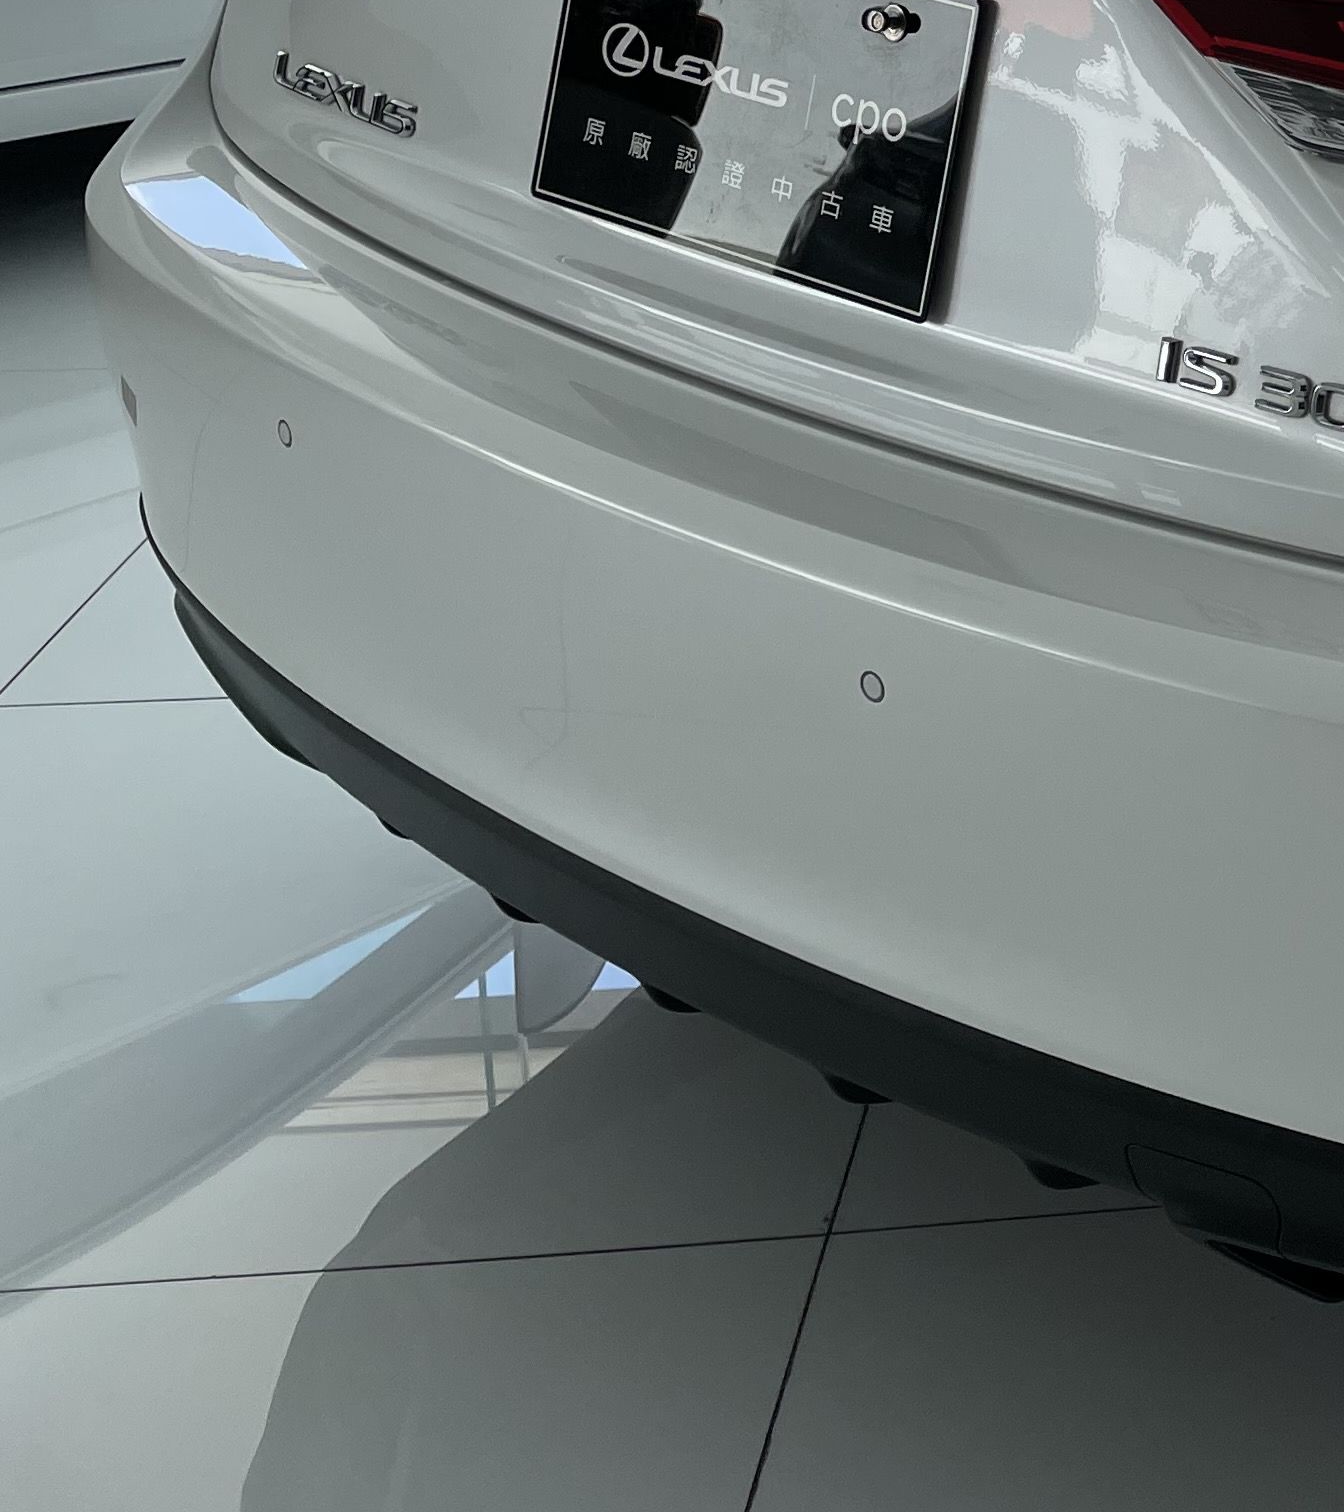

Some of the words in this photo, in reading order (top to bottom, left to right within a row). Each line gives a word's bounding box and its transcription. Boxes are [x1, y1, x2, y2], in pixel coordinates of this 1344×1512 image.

[273, 50, 418, 138] LEXUS
[652, 46, 789, 108] LEXUS
[831, 93, 907, 145] cpo
[582, 117, 894, 233] 原廠認證中古車
[1155, 337, 1240, 397] IS
